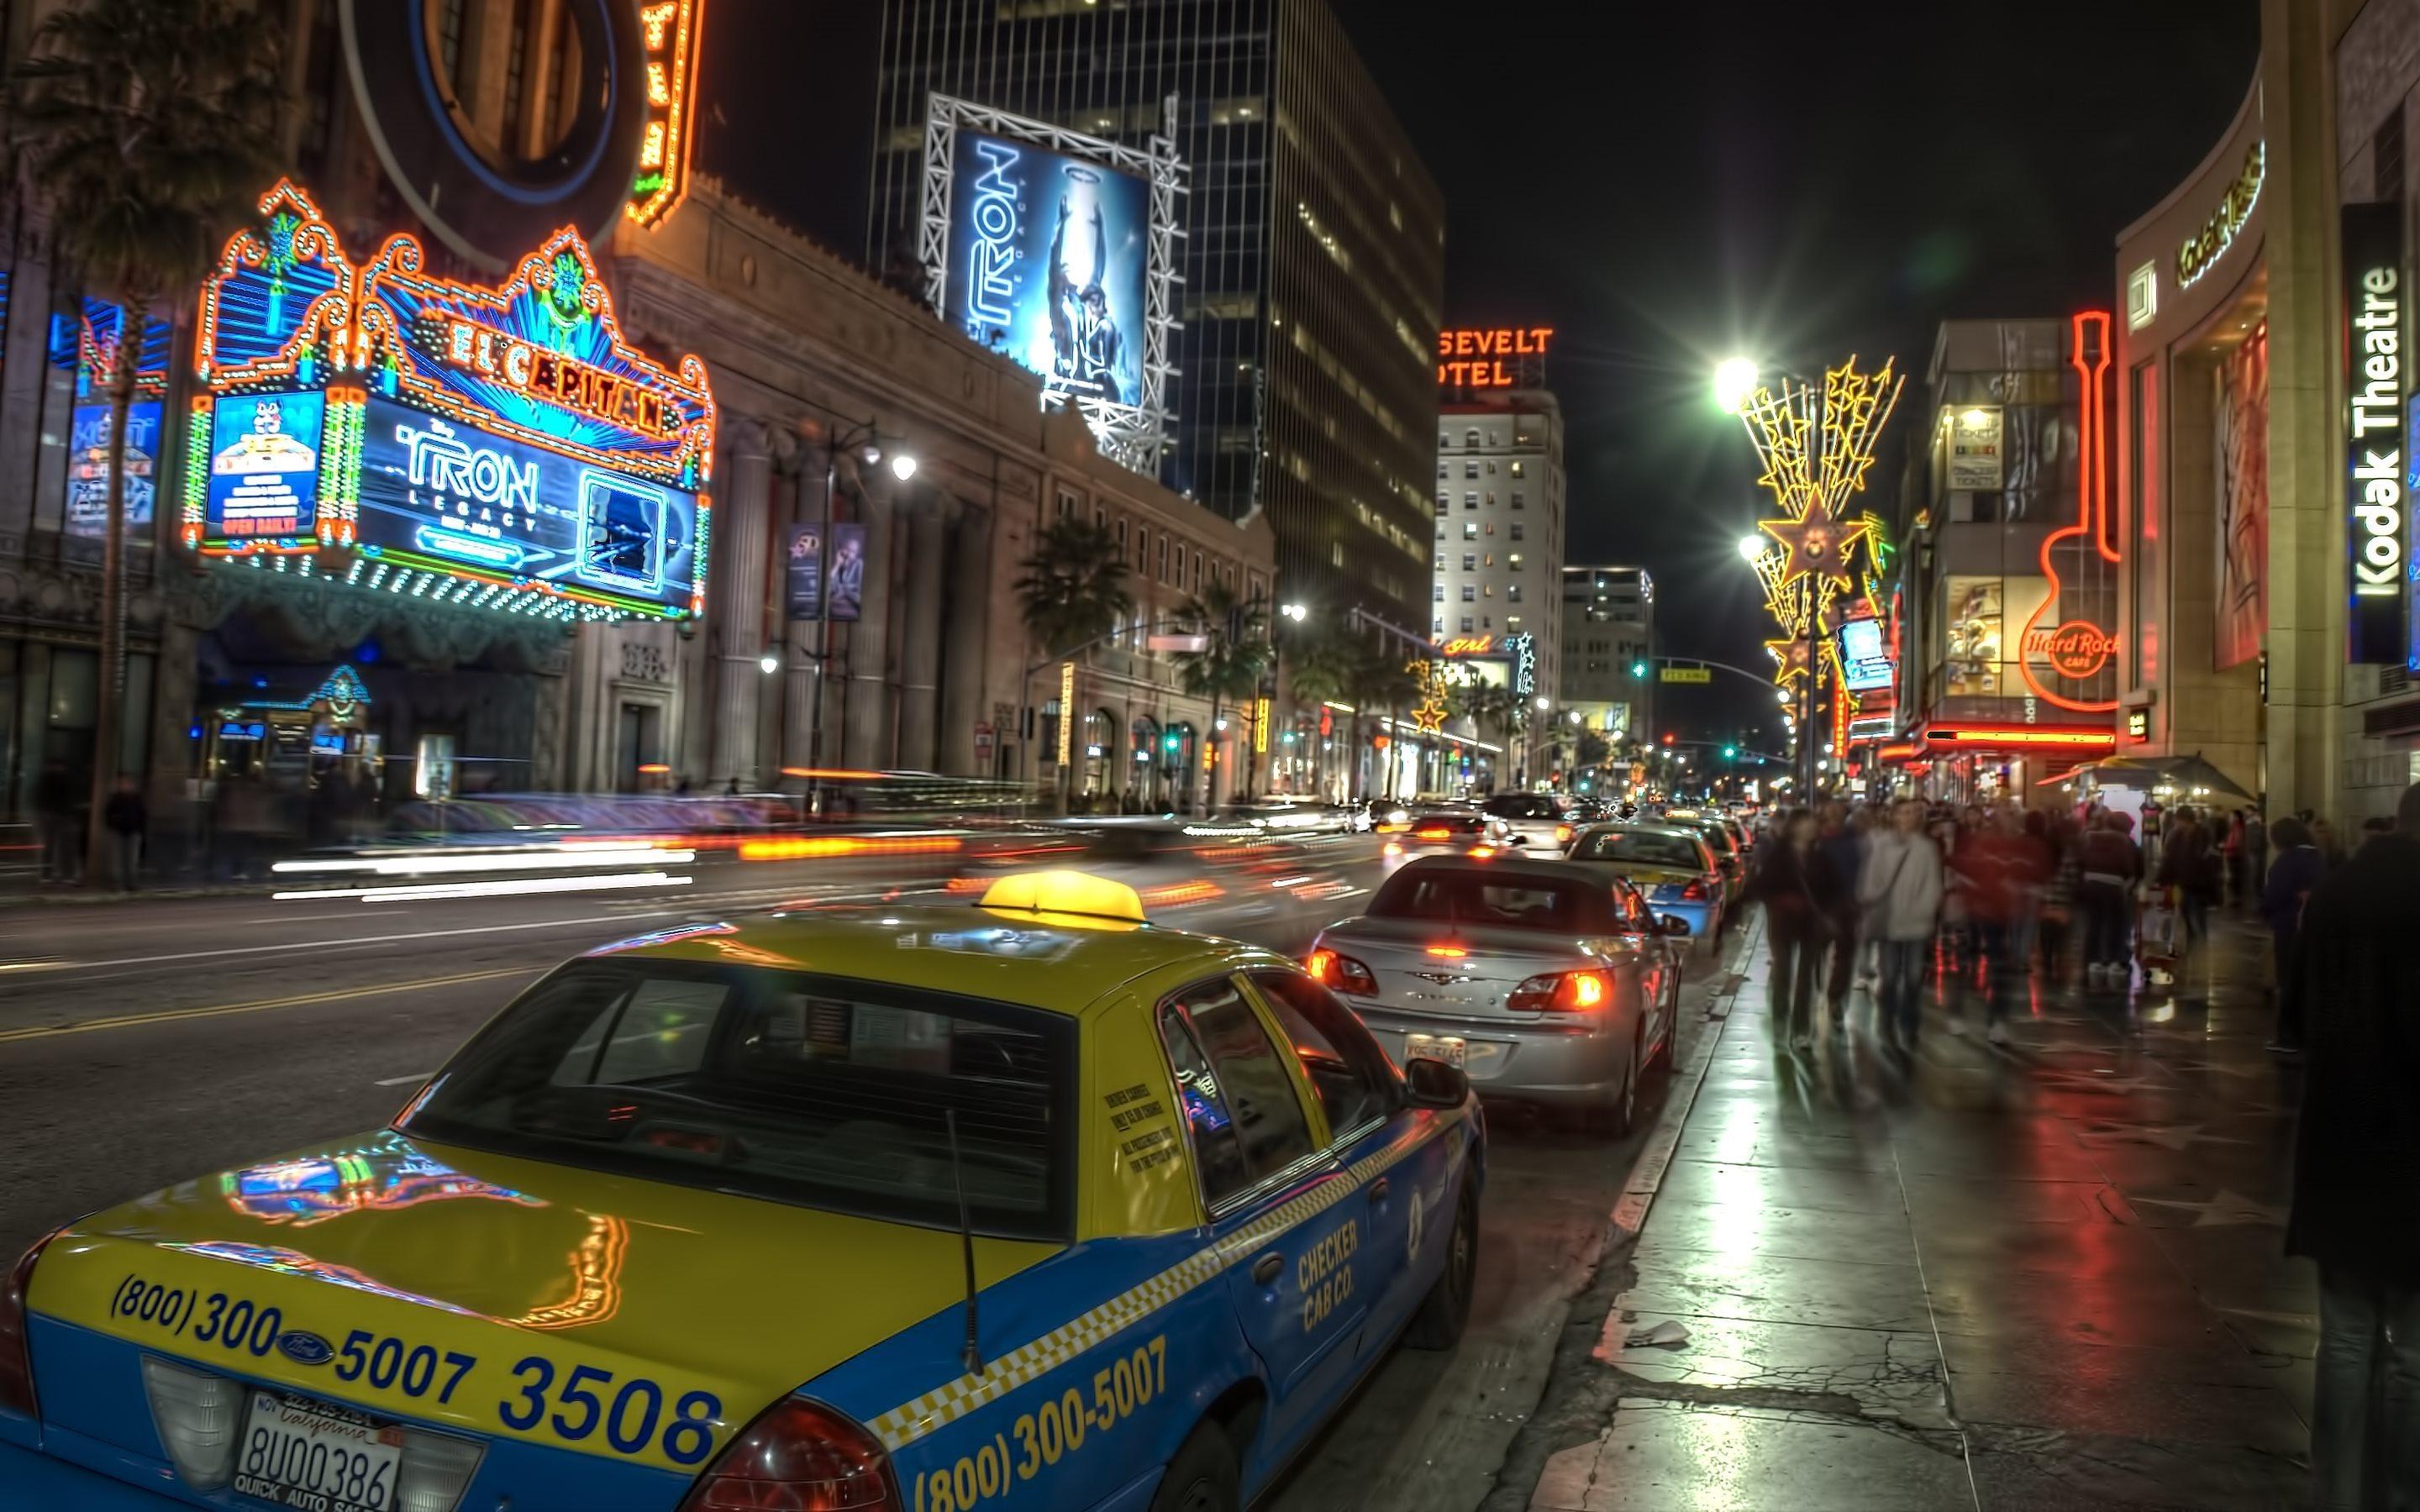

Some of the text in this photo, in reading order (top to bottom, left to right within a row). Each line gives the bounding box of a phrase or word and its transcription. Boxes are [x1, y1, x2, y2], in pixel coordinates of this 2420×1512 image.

[966, 139, 1022, 341] TRON
[1012, 178, 1028, 308] LEGACY
[448, 319, 665, 435] EL CAPITAN
[1438, 328, 1553, 355] SEVELT
[2351, 265, 2401, 596] Kodak Theatre
[395, 423, 541, 515] TRON
[408, 489, 537, 533] LEGACY
[2027, 632, 2121, 658] Hard Rock
[1297, 1219, 1359, 1294] CHECKER
[111, 1273, 282, 1357] (800) 300
[1303, 1281, 1333, 1334] CAB
[286, 1335, 321, 1357] Ford
[334, 1329, 478, 1404] 5007
[256, 1398, 278, 1414] NOV
[280, 1406, 377, 1446] California
[498, 1356, 723, 1466] 3508
[914, 1334, 1166, 1512] (800) 300-5007
[234, 1473, 281, 1502] QUICK
[286, 1488, 329, 1512] AUTO
[247, 1427, 392, 1509] 8U00386
